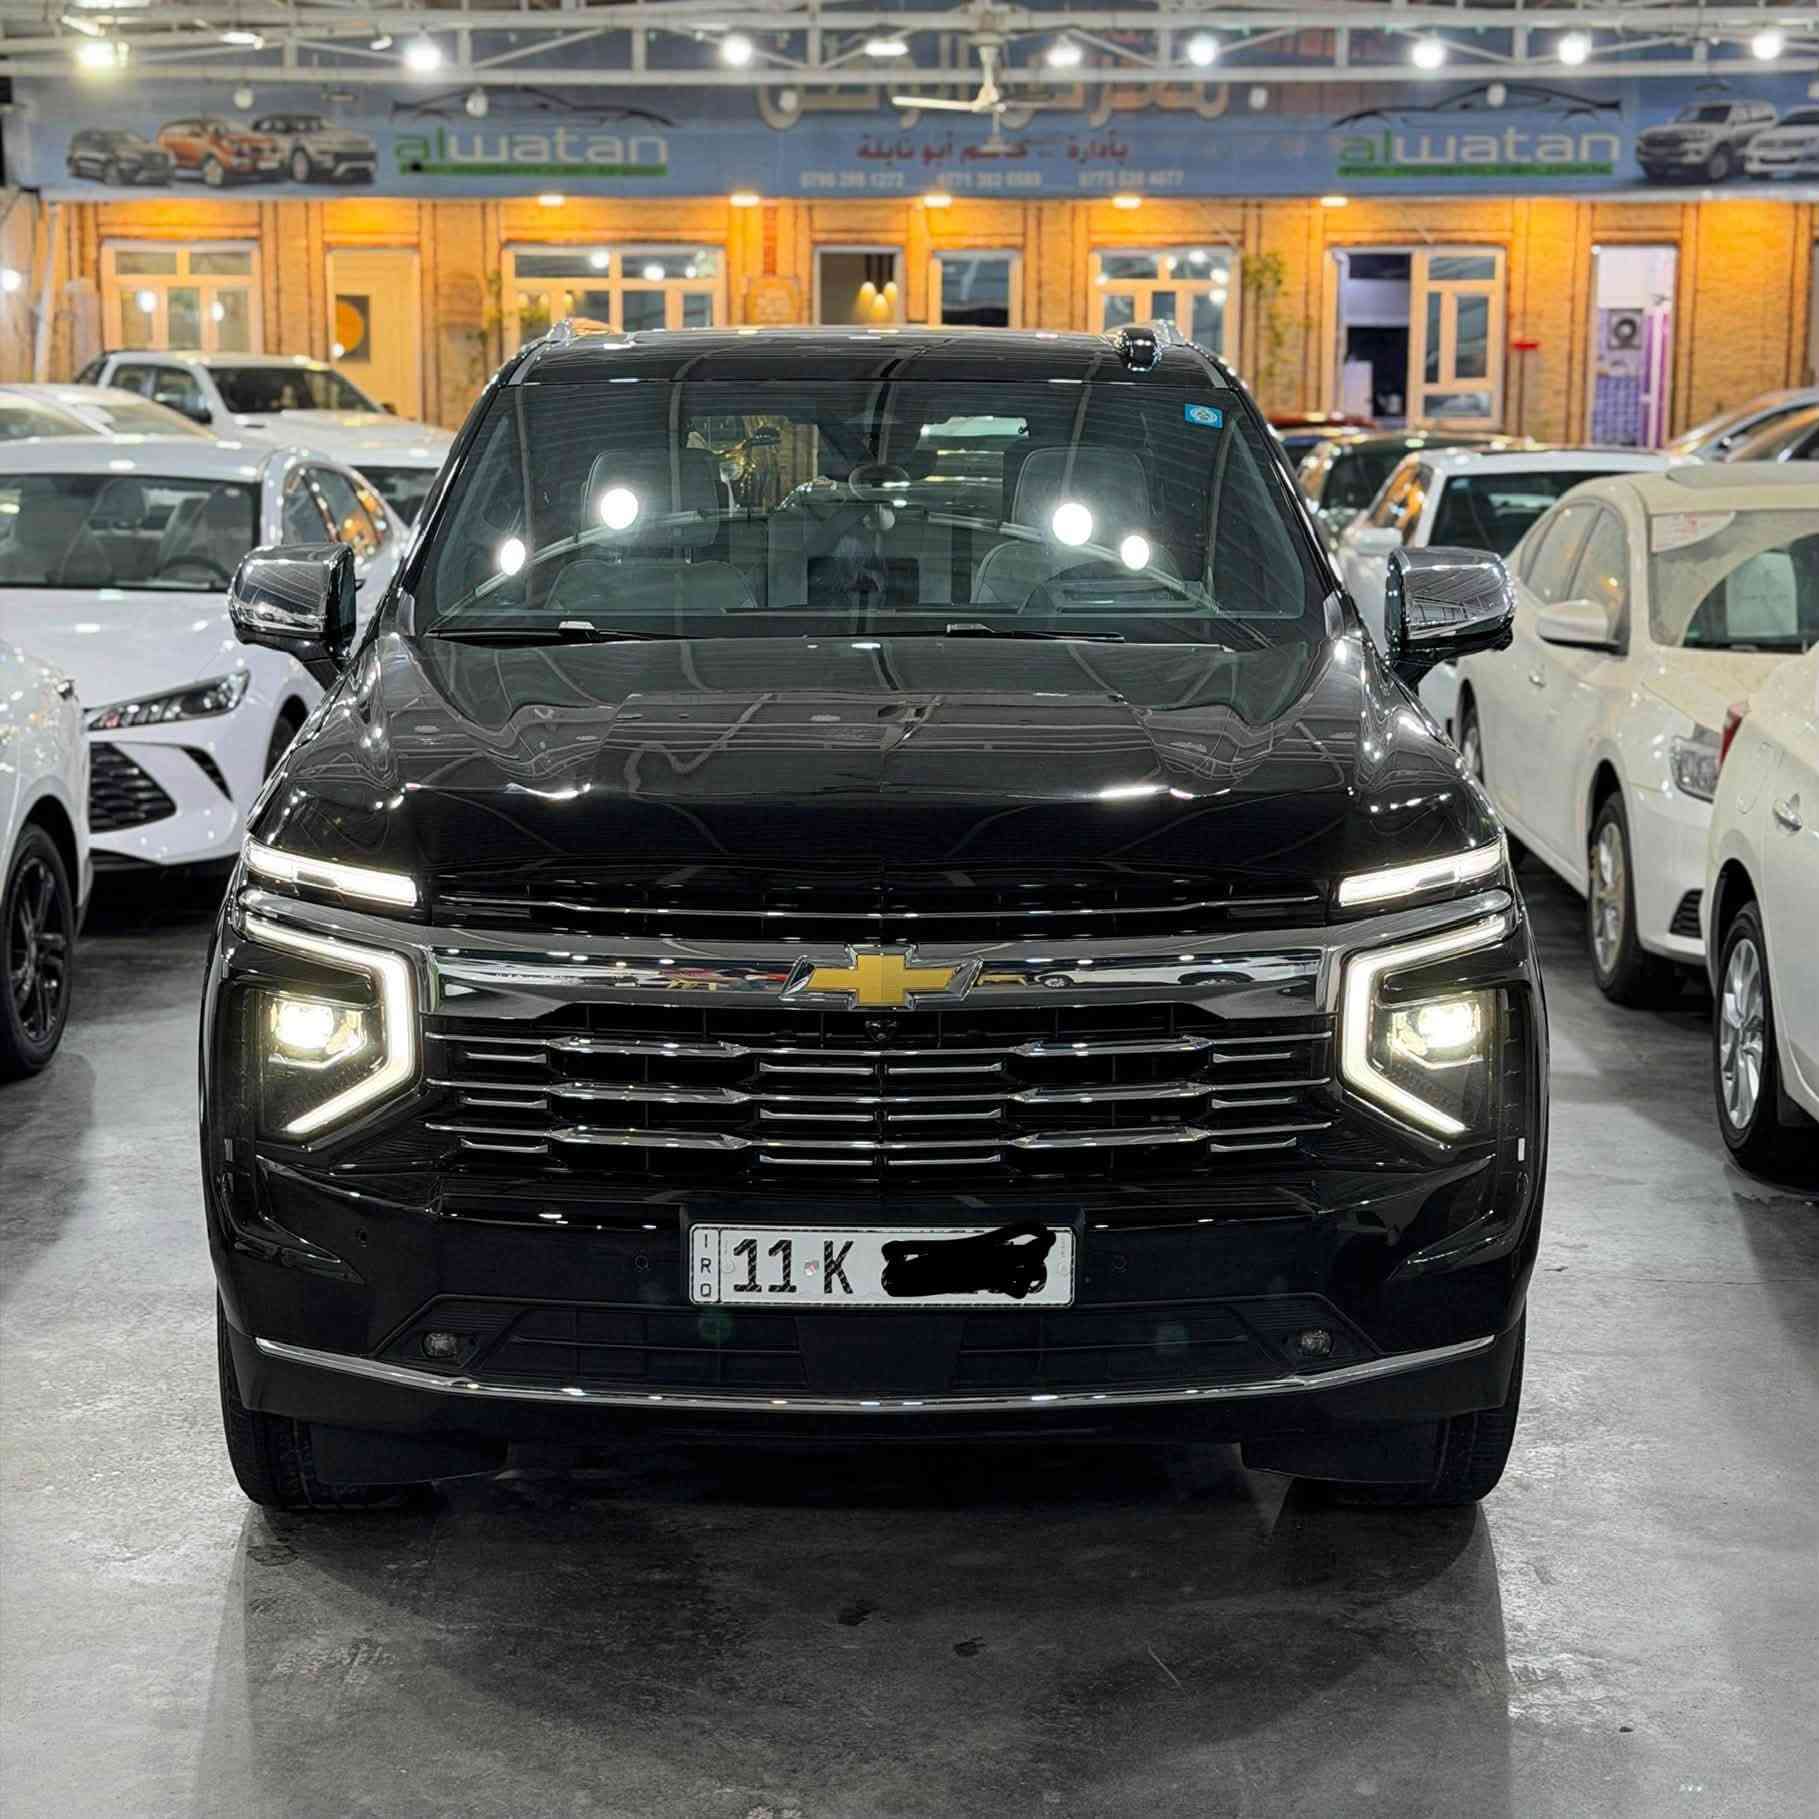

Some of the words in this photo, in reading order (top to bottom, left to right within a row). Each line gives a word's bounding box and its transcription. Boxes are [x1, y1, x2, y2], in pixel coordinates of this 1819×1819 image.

[395, 126, 669, 164] alwatan
[1338, 126, 1621, 164] alwatan
[733, 1238, 797, 1294] 11
[823, 1240, 854, 1295] K
